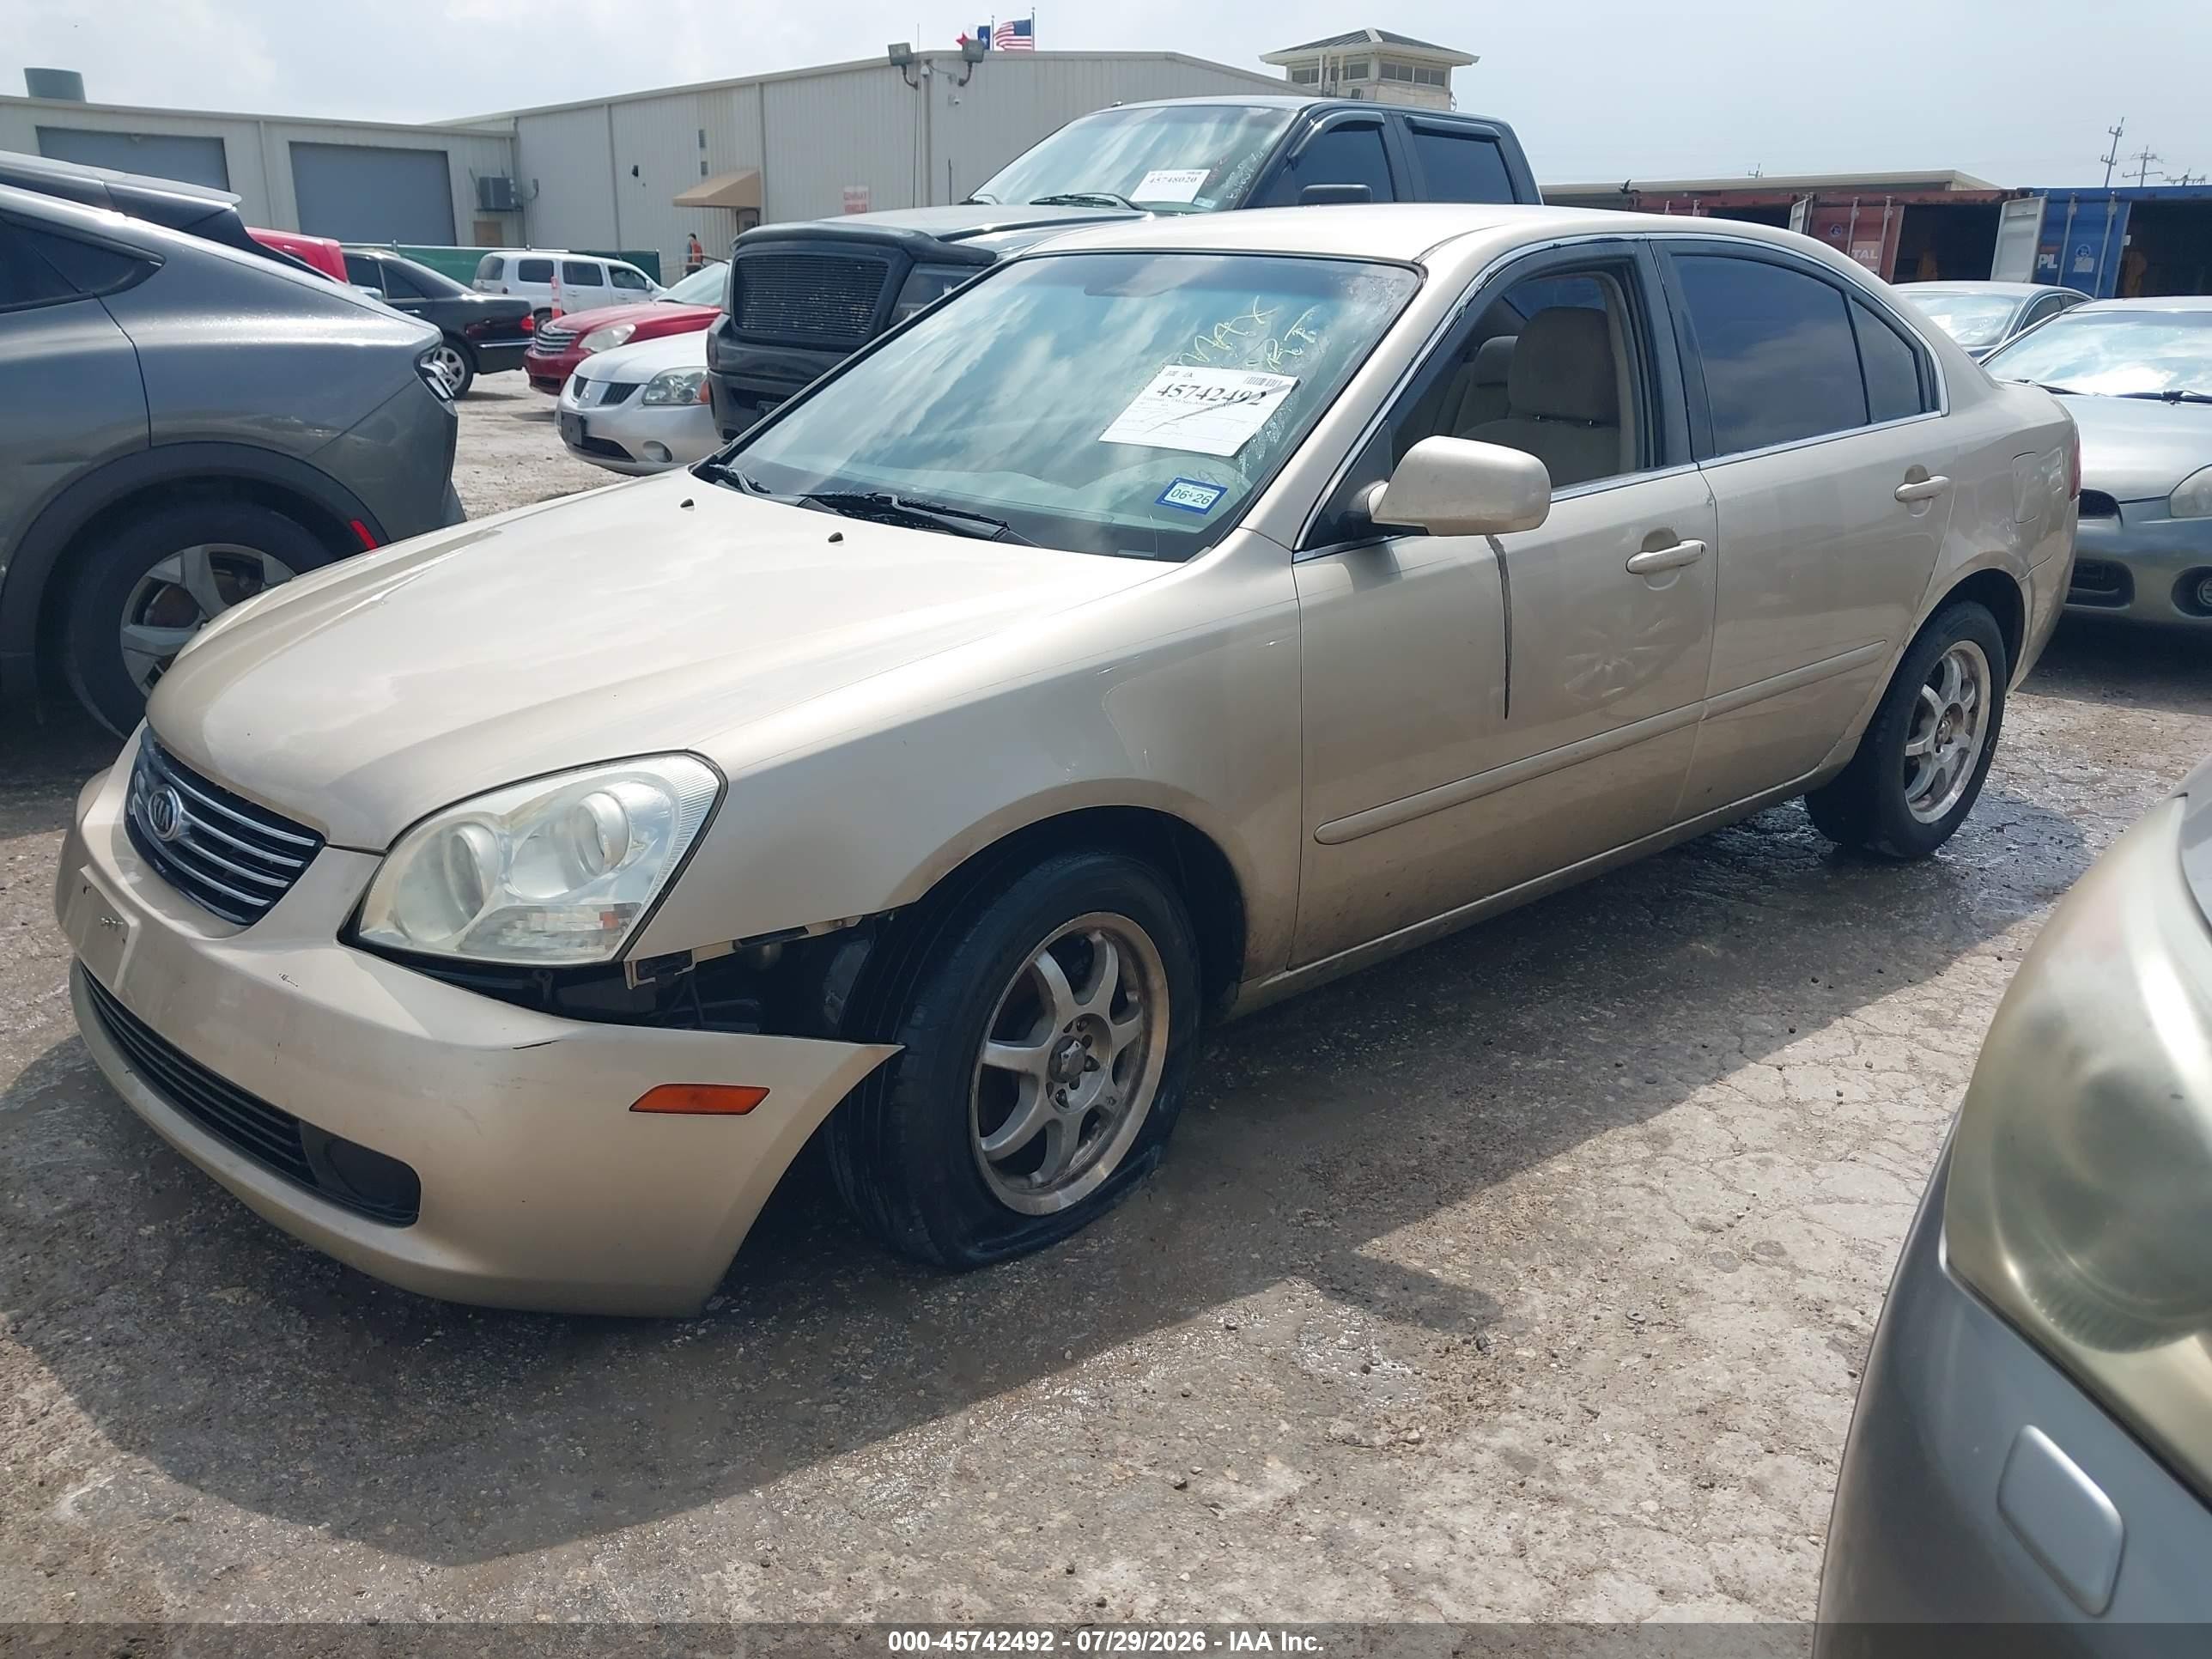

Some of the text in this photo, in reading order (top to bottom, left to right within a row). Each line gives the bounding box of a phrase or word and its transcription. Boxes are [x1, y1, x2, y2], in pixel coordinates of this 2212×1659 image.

[1157, 383, 1267, 405] 45742492
[1170, 488, 1190, 500] 06
[1191, 493, 1212, 505] 26
